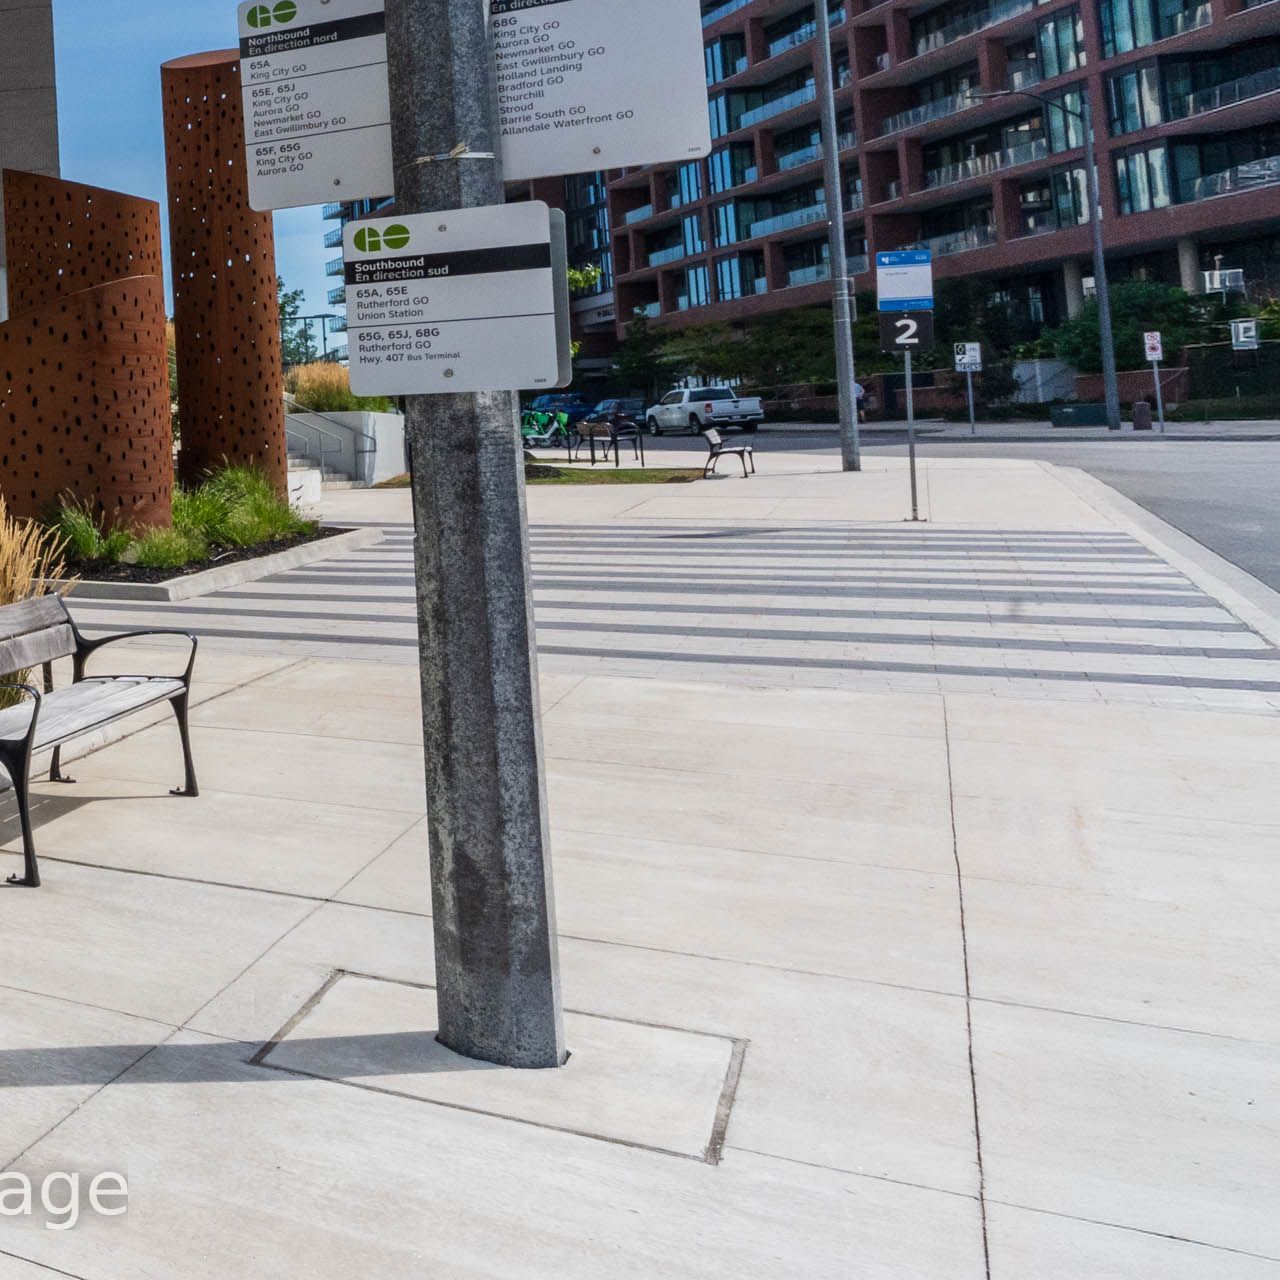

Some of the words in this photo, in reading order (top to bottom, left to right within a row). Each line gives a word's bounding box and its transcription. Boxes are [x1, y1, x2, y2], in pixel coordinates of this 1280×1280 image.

[247, 0, 296, 28] GO
[492, 3, 506, 12] En
[493, 17, 517, 28] 68G
[494, 29, 516, 39] King
[520, 25, 540, 35] City
[543, 21, 560, 30] GO
[248, 28, 310, 46] Northbound
[249, 47, 261, 56] En
[265, 38, 310, 53] direction
[313, 32, 337, 43] nord
[495, 38, 529, 49] Aurora
[533, 34, 550, 43] GO
[496, 44, 555, 60] Newmarket
[558, 40, 575, 50] GO
[250, 60, 270, 70] 65A
[497, 62, 518, 71] East
[522, 51, 584, 67] Gwillimbury
[588, 47, 605, 56] GO
[251, 71, 270, 80] King
[272, 67, 289, 76] City
[292, 64, 306, 72] GO
[497, 69, 537, 82] Holland
[540, 62, 582, 75] Landing
[252, 88, 274, 97] 65E,
[278, 84, 295, 93] 65J
[498, 79, 543, 93] Bradford
[547, 76, 564, 85] GO
[253, 99, 271, 107] King
[274, 96, 291, 104] City
[294, 92, 308, 100] GO
[499, 90, 544, 104] Churchill
[253, 108, 282, 118] Aurora
[286, 104, 299, 112] GO
[500, 103, 534, 114] Stroud
[501, 114, 532, 125] Barrie
[535, 109, 565, 120] South
[569, 106, 586, 115] GO
[254, 113, 304, 127] Newmarket
[307, 110, 321, 119] GO
[502, 122, 550, 136] Allandale
[554, 113, 612, 128] Waterfront
[616, 110, 633, 120] GO
[254, 128, 273, 137] East
[276, 121, 328, 134] Gwillimbury
[332, 117, 346, 125] GO
[256, 147, 276, 156] 65F,
[280, 143, 300, 152] 65G
[256, 158, 275, 166] King
[278, 155, 295, 163] City
[298, 152, 312, 160] GO
[257, 167, 286, 176] Aurora
[290, 163, 304, 172] GO
[354, 224, 410, 252] GO
[355, 257, 424, 272] Southbound
[356, 273, 369, 282] En
[373, 269, 424, 281] direction
[428, 266, 448, 276] sud
[356, 289, 382, 298] 65A,
[386, 286, 408, 295] 65E
[357, 298, 409, 309] Rutherford
[413, 296, 429, 305] GO
[358, 311, 385, 320] Union
[389, 309, 423, 318] Station
[359, 332, 384, 341] 65G,
[388, 330, 412, 339] 65J,
[416, 328, 440, 337] 68G
[895, 319, 919, 344] 2
[359, 342, 412, 352] Rutherford
[415, 341, 431, 349] GO
[360, 356, 382, 365] Hwy.
[386, 354, 404, 362] 407
[425, 352, 460, 360] Terminal
